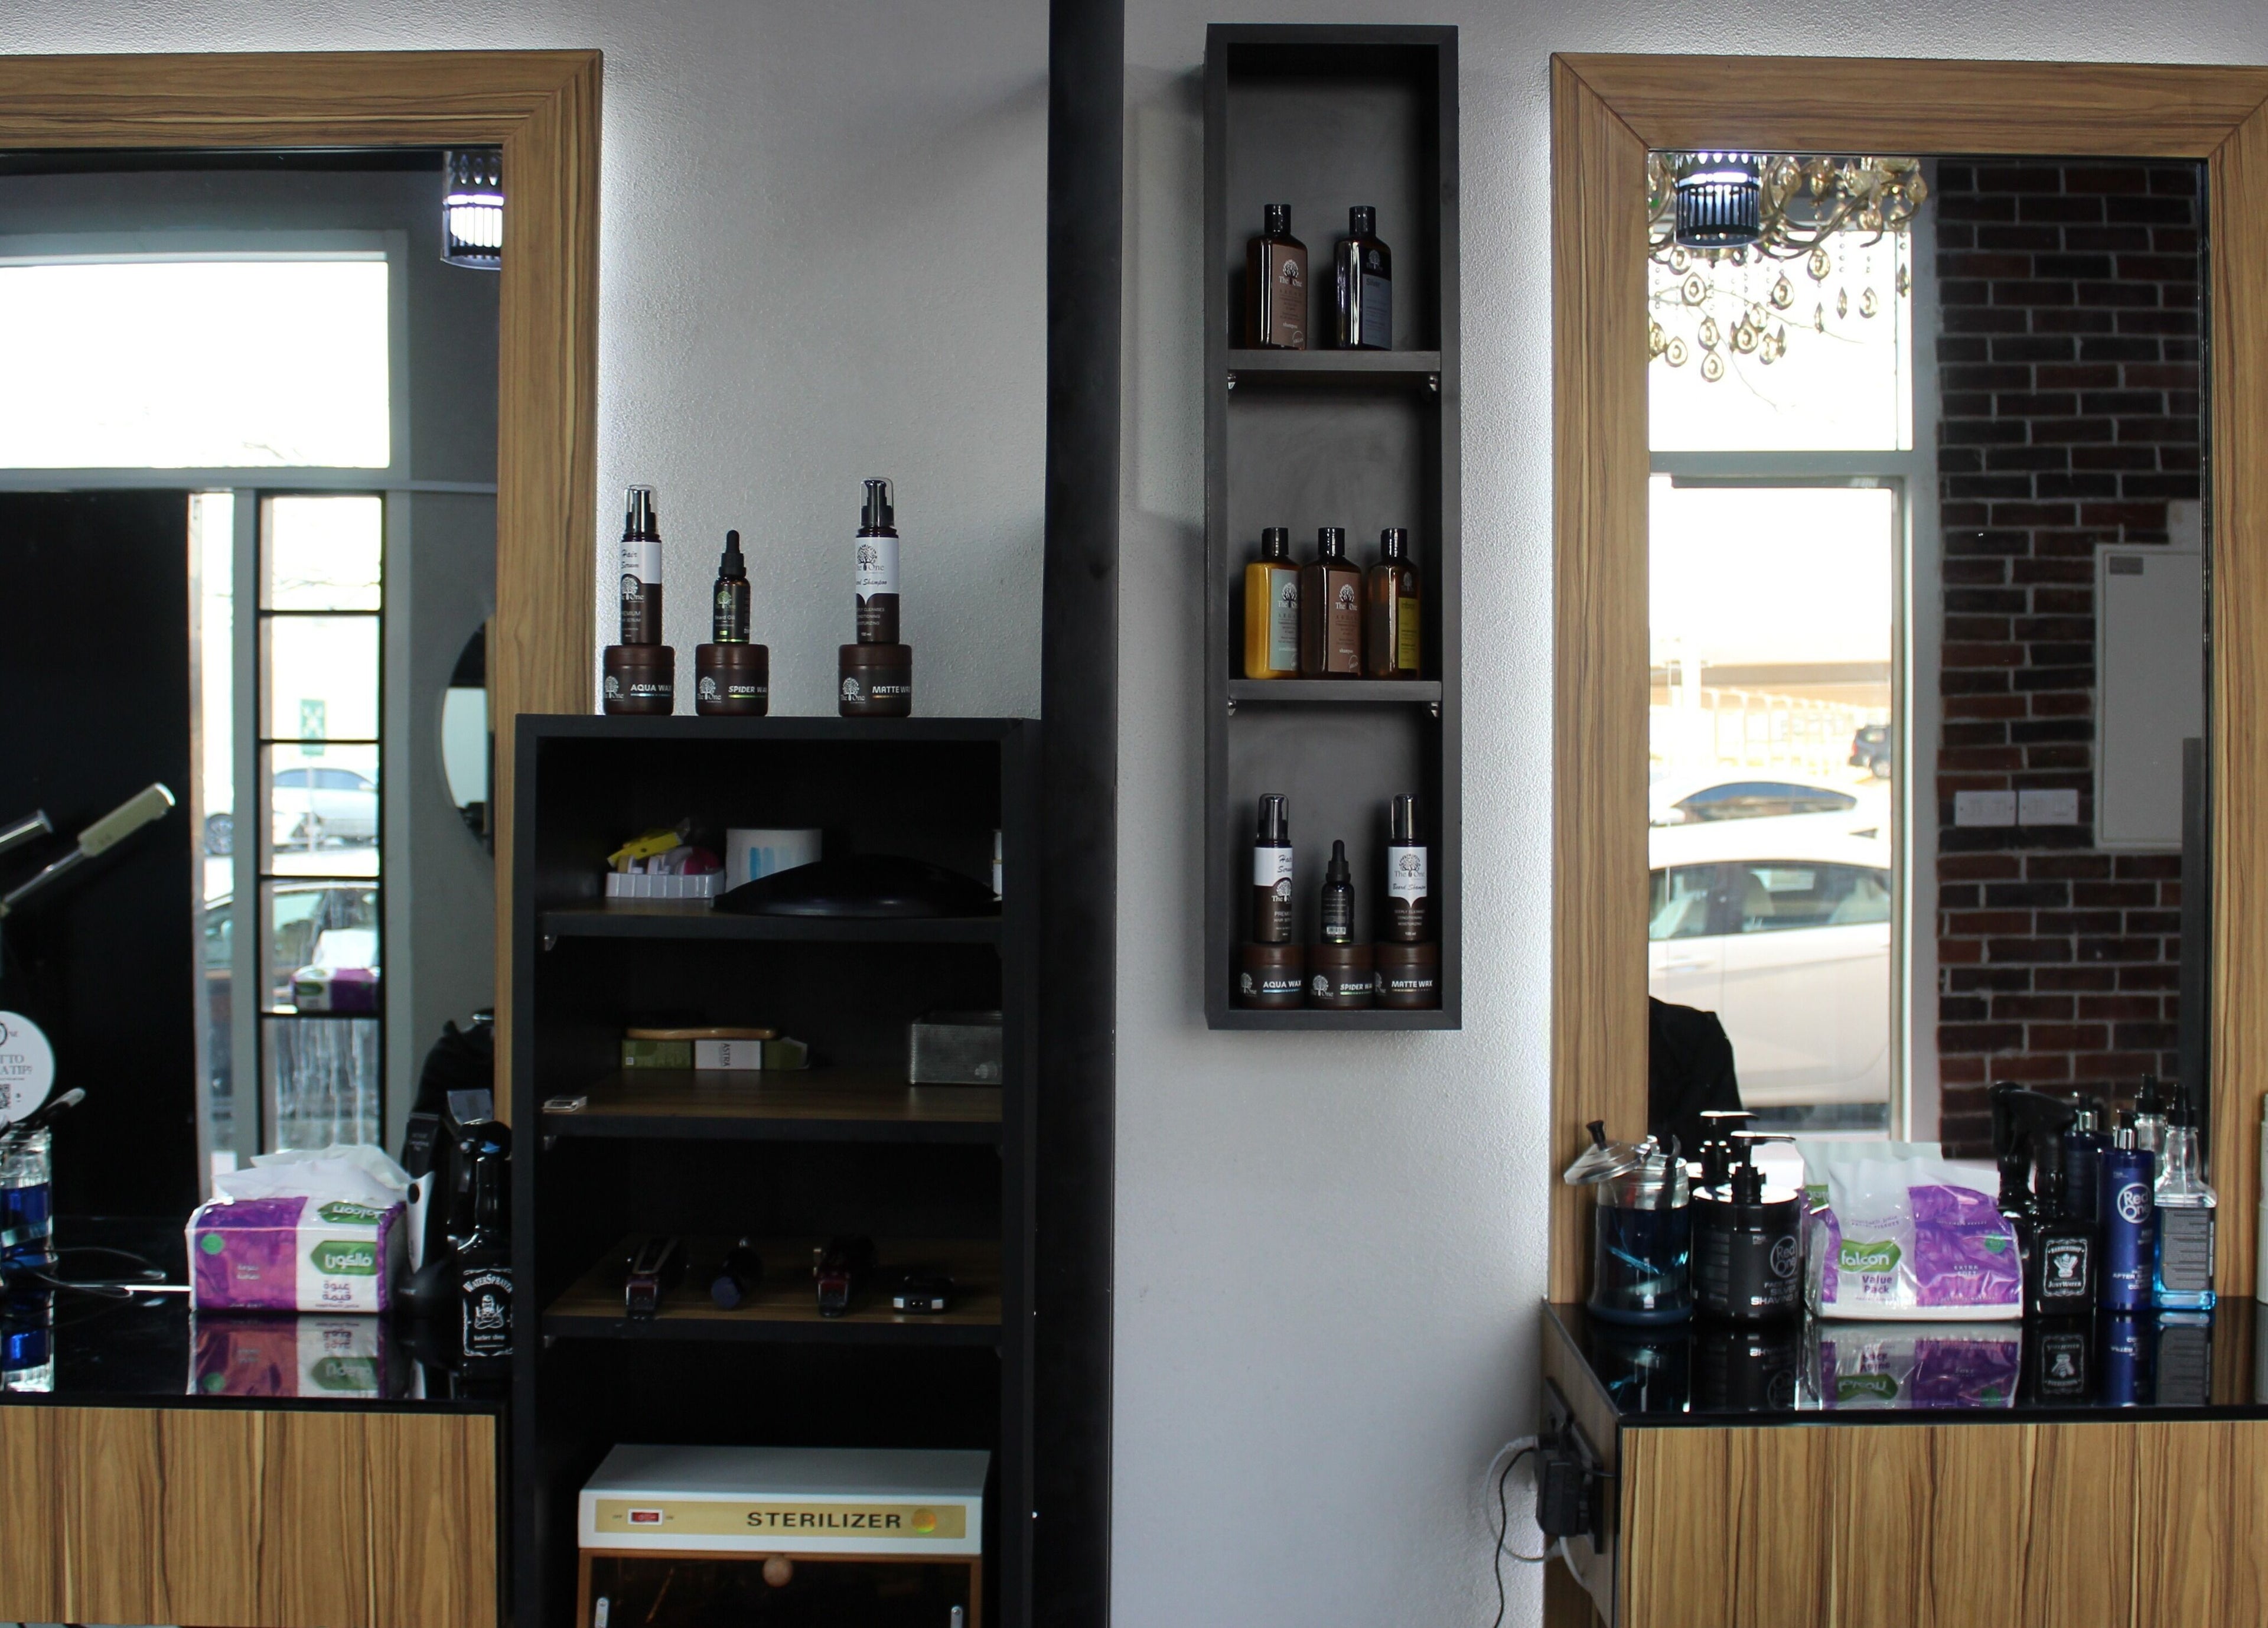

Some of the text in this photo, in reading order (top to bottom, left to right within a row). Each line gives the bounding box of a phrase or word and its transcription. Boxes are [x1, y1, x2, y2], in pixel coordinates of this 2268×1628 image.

[1279, 276, 1289, 284] The
[8, 1054, 25, 1063] TO
[2124, 1191, 2149, 1206] Red
[2123, 1203, 2149, 1220] One
[1776, 1243, 1795, 1260] Red
[1841, 1249, 1889, 1266] falcon
[325, 1252, 373, 1269] فالكون
[1776, 1257, 1796, 1274] One
[323, 1280, 350, 1292] عبوة
[1862, 1275, 1892, 1284] Value
[1864, 1285, 1889, 1294] Pack
[322, 1291, 351, 1304] قيمة
[747, 1512, 902, 1529] STERILIZER
